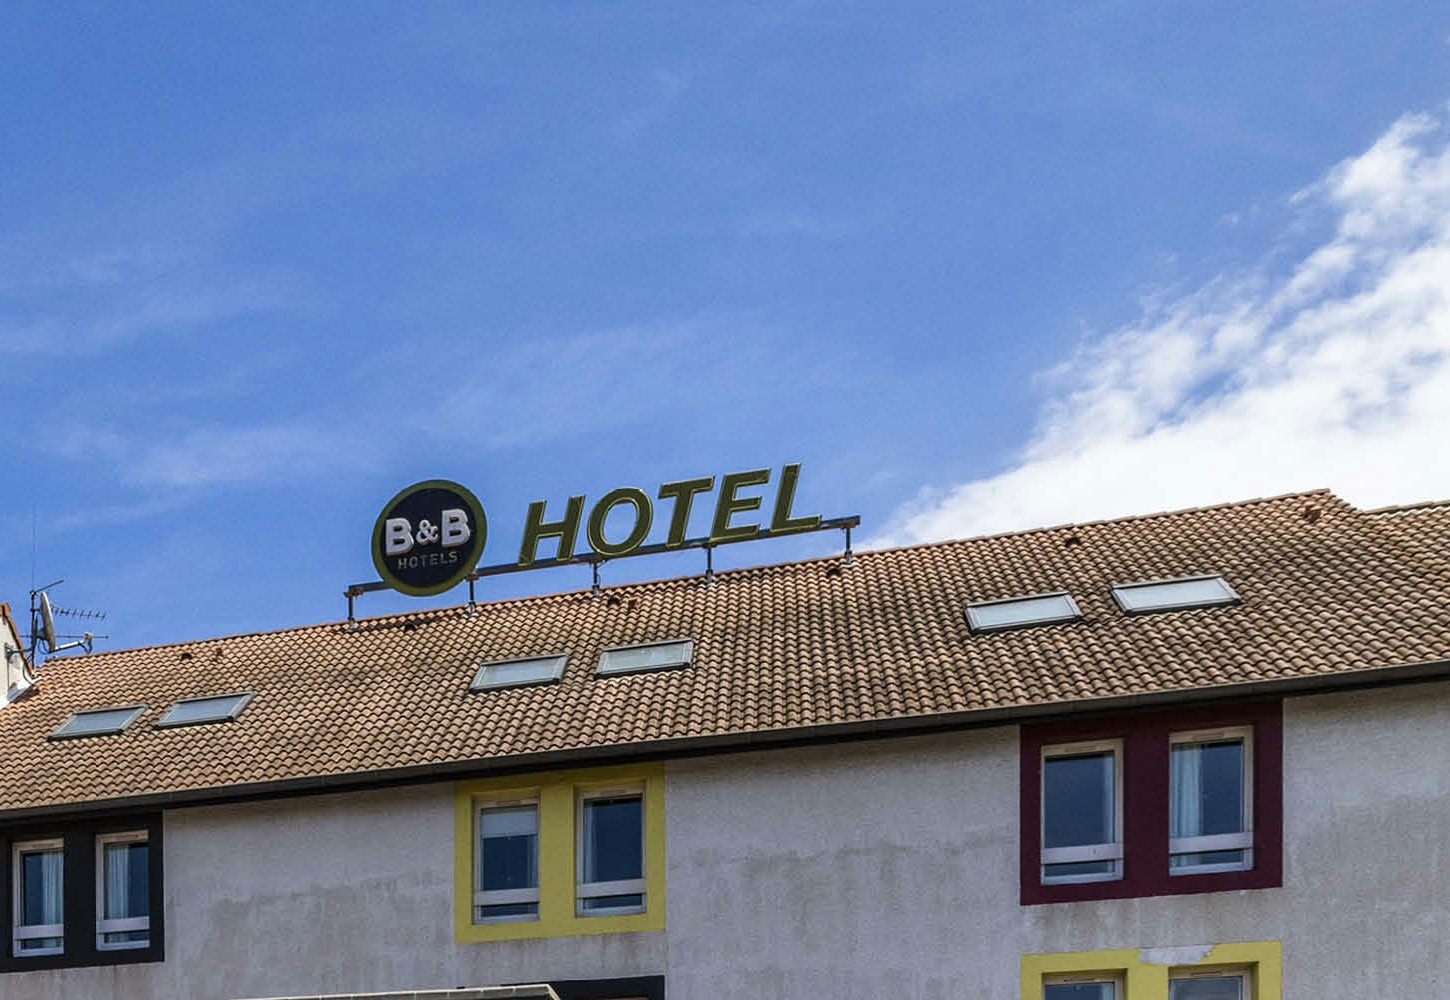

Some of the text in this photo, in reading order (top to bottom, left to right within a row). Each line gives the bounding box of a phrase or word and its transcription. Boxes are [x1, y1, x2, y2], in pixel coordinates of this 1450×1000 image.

[385, 508, 471, 556] B&B
[518, 463, 823, 567] HOTEL
[397, 551, 459, 569] HOTELS
